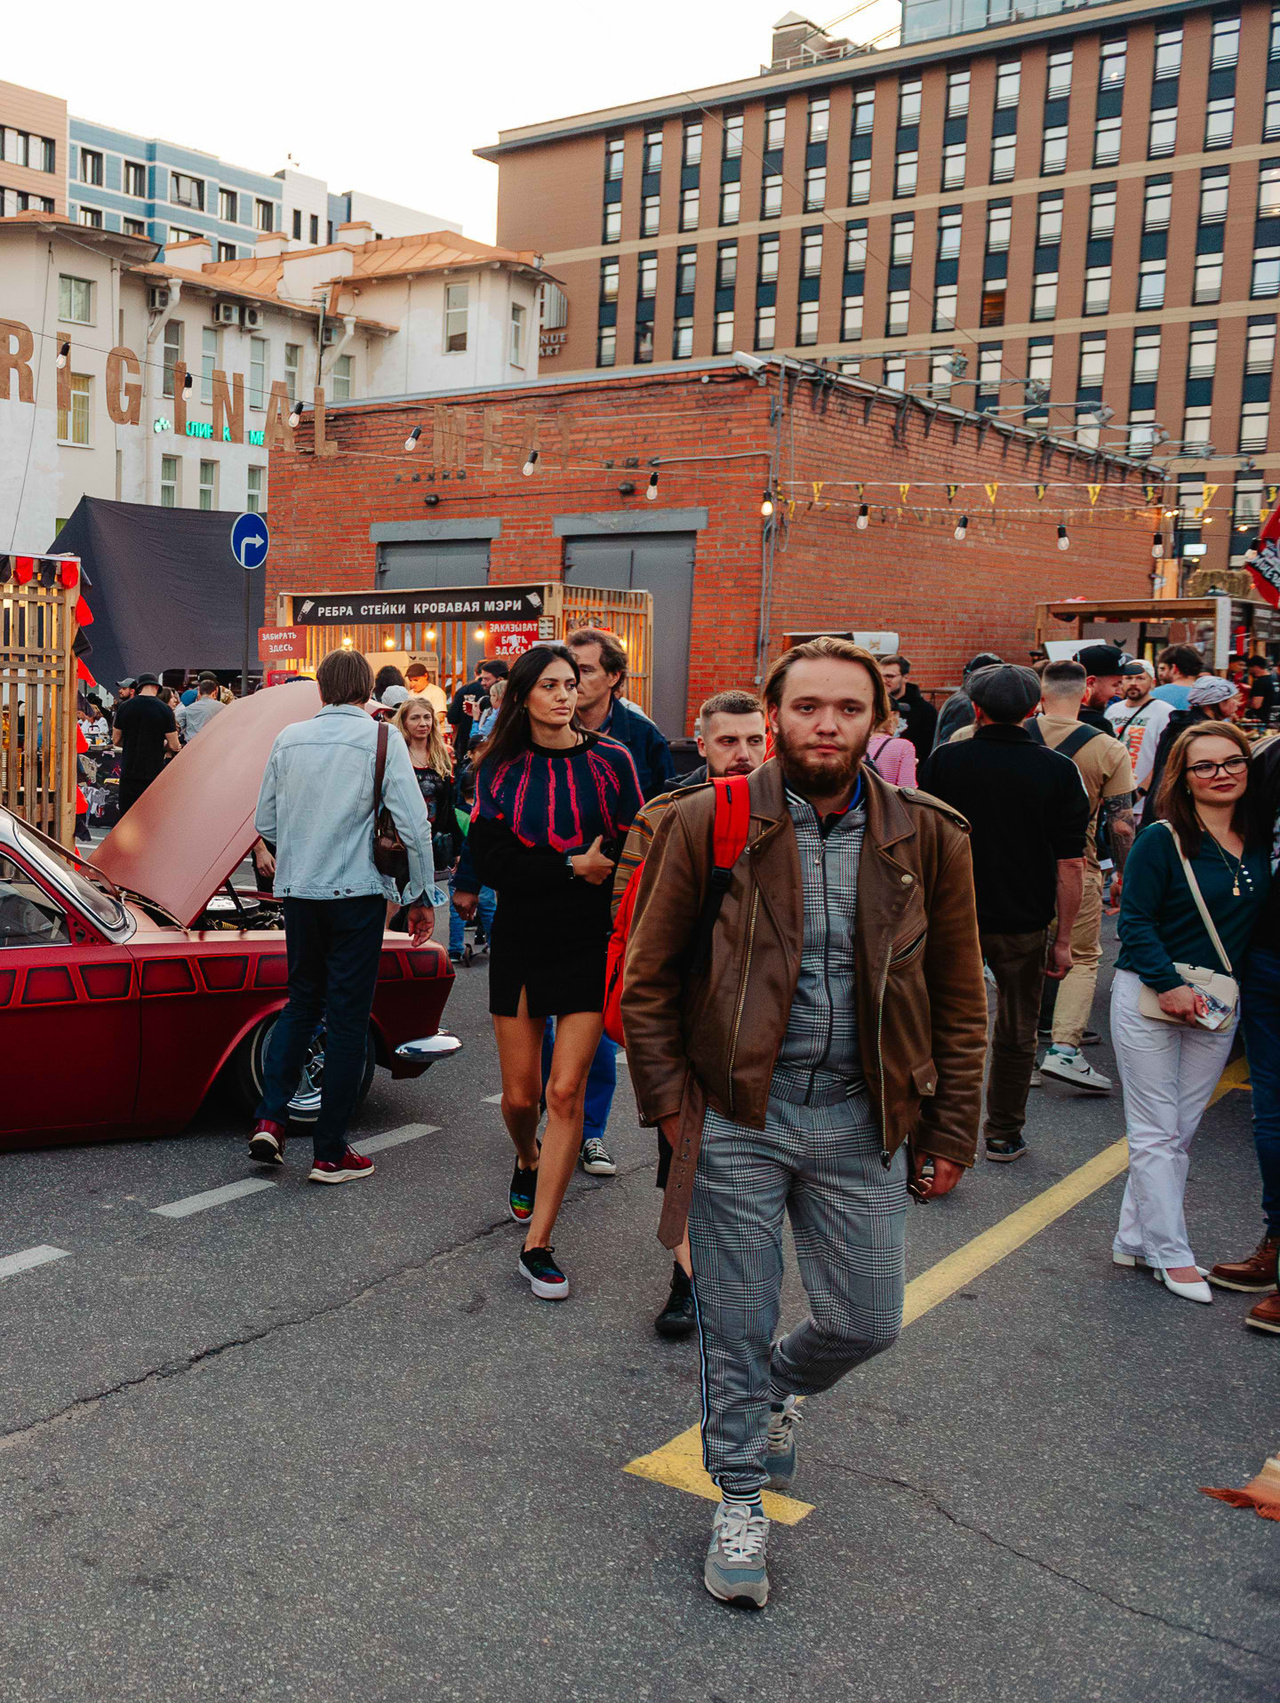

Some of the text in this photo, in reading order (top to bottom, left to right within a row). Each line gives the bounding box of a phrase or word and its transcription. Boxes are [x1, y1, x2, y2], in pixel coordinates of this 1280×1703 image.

[317, 599, 522, 617] РЕБРА СТЕЙКИ КРОВАВАЯ МЭРИ
[489, 623, 538, 632] ЗАКАЗЫВАТ
[261, 632, 297, 641] ЗАБИРАТЬ
